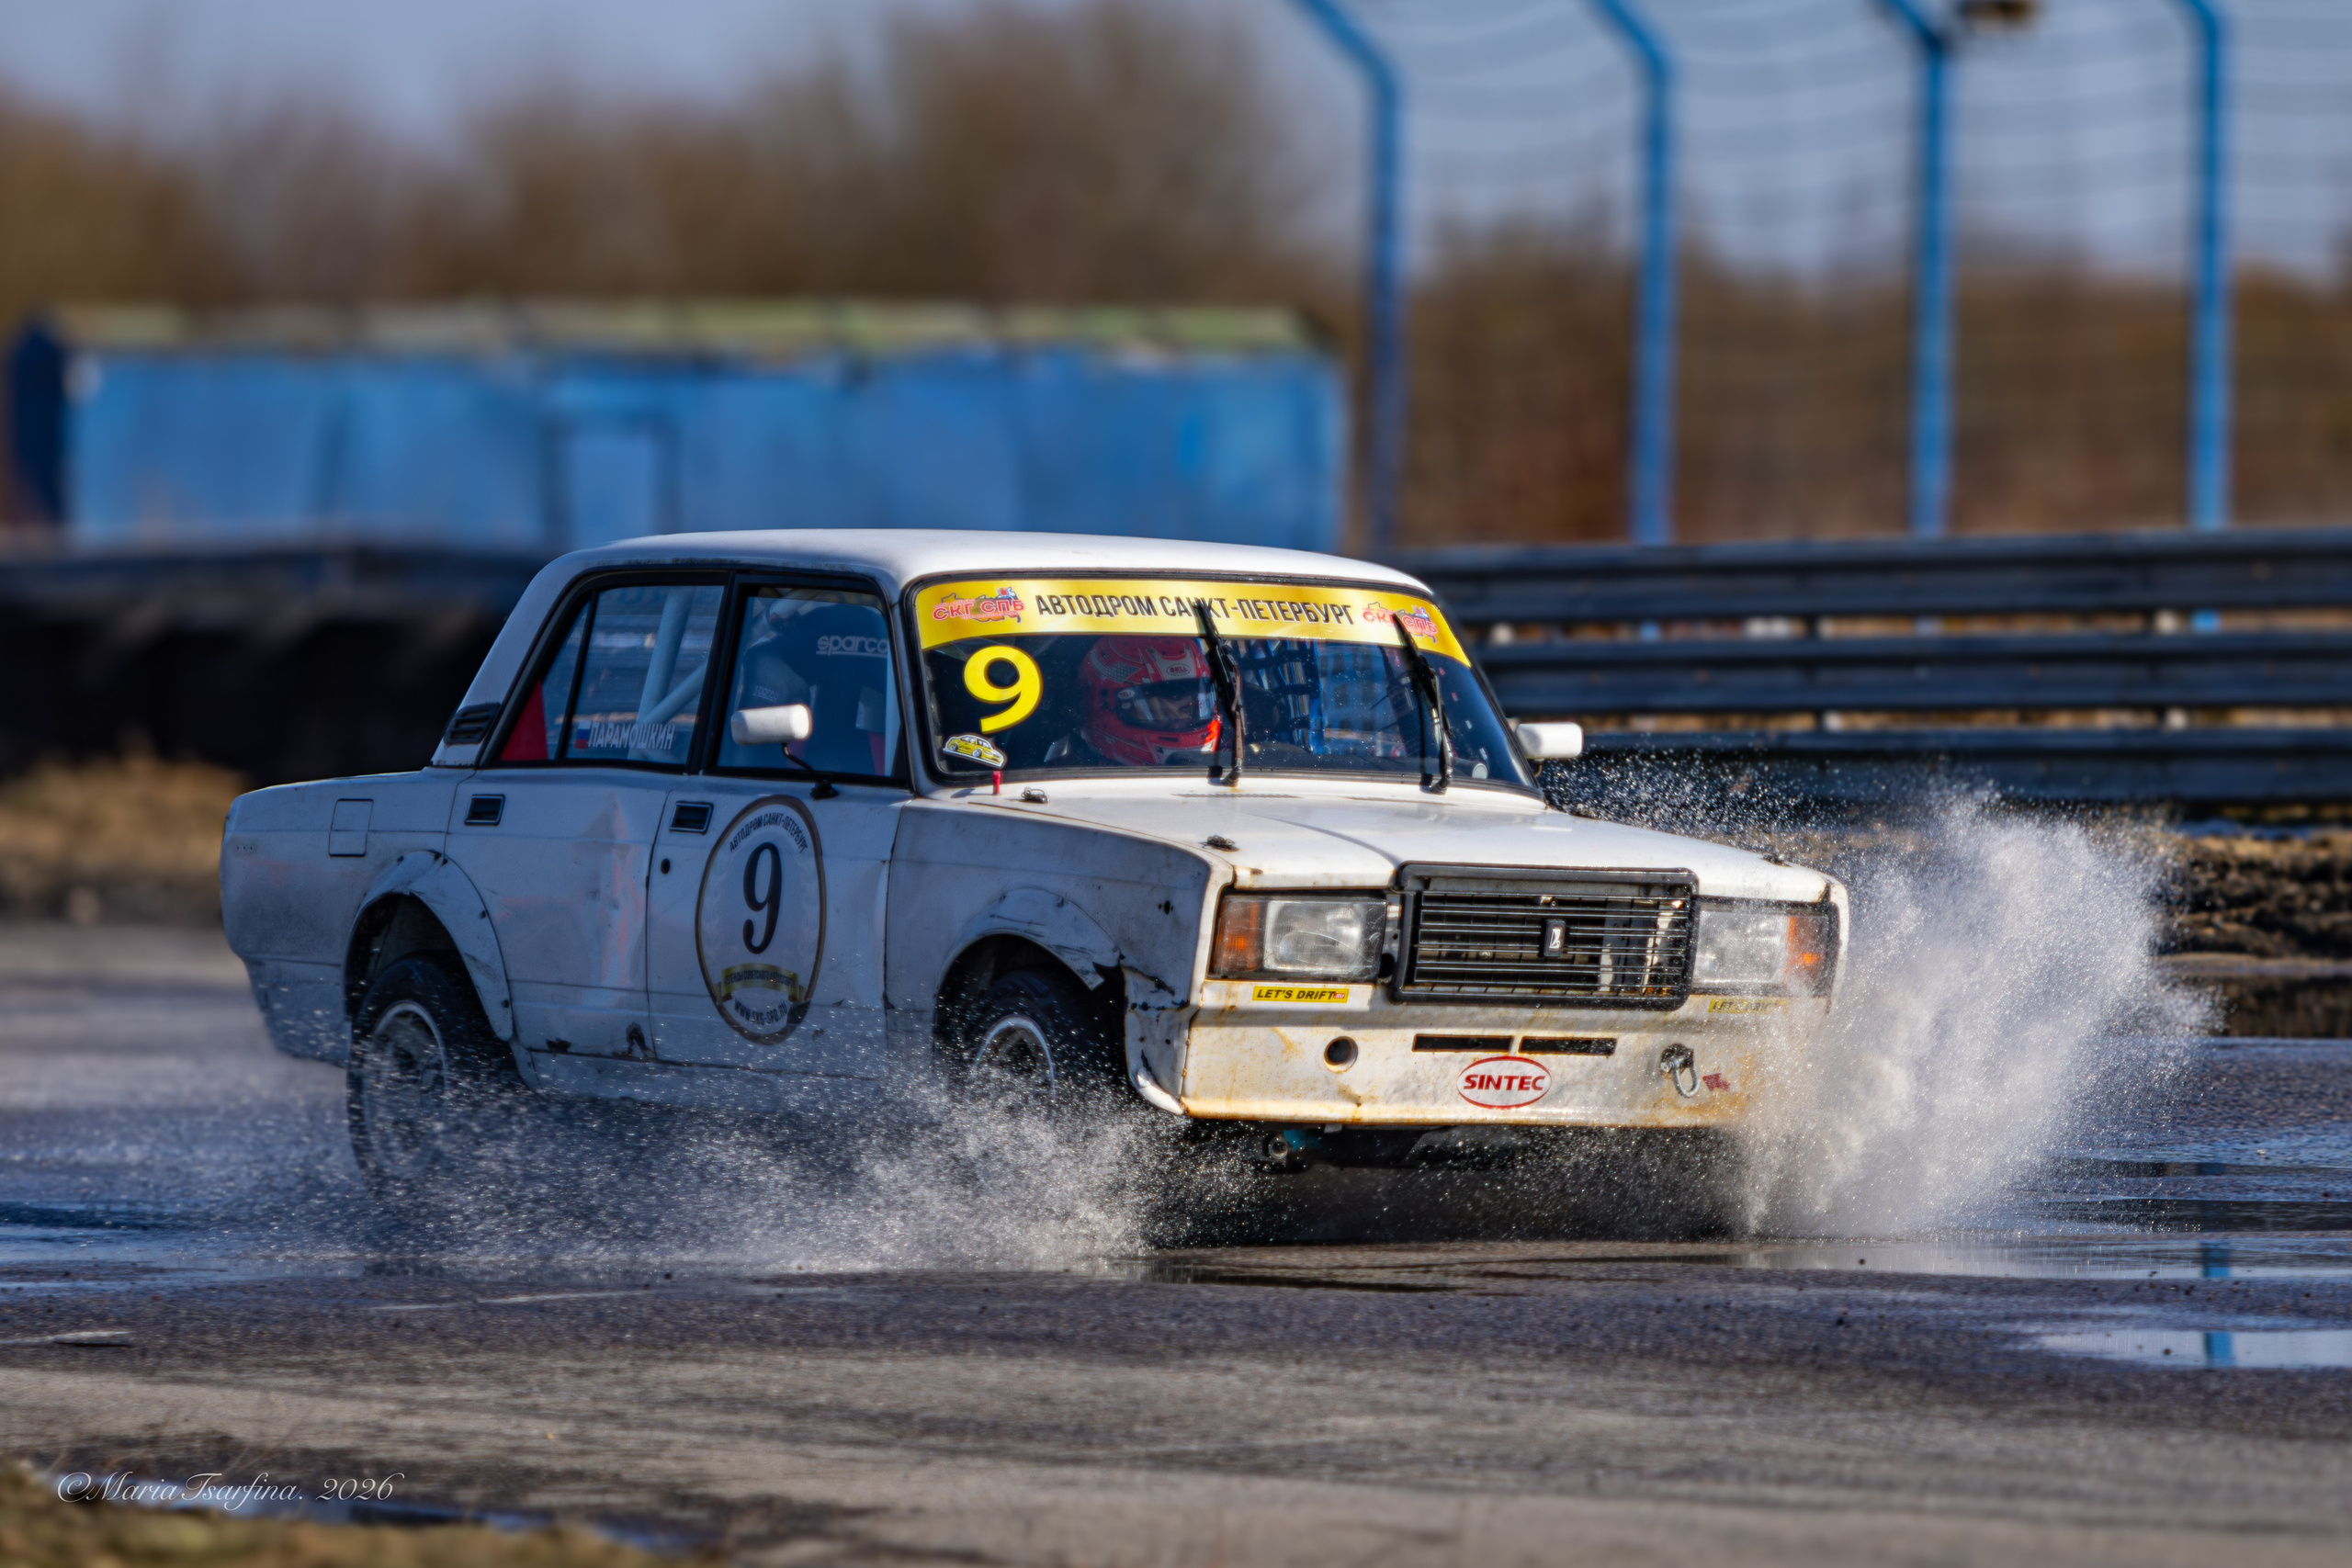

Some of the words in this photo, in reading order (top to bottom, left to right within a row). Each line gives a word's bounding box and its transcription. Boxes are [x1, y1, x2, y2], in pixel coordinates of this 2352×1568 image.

[933, 602, 974, 621] СКГ
[980, 599, 1025, 614] СПБ
[1035, 594, 1159, 618] АВТОДРОМ
[1401, 615, 1438, 634] СПБ
[816, 635, 888, 658] sparco
[963, 645, 1042, 734] 9
[588, 721, 675, 750] ПАРАМОШКИН
[729, 815, 763, 853] АВТОДРОМ
[763, 812, 808, 853] САНКТ-ПЕТЕРБУРГ
[742, 841, 783, 954] 9
[1256, 988, 1293, 999] LET'S
[1463, 1074, 1545, 1092] SINTEC
